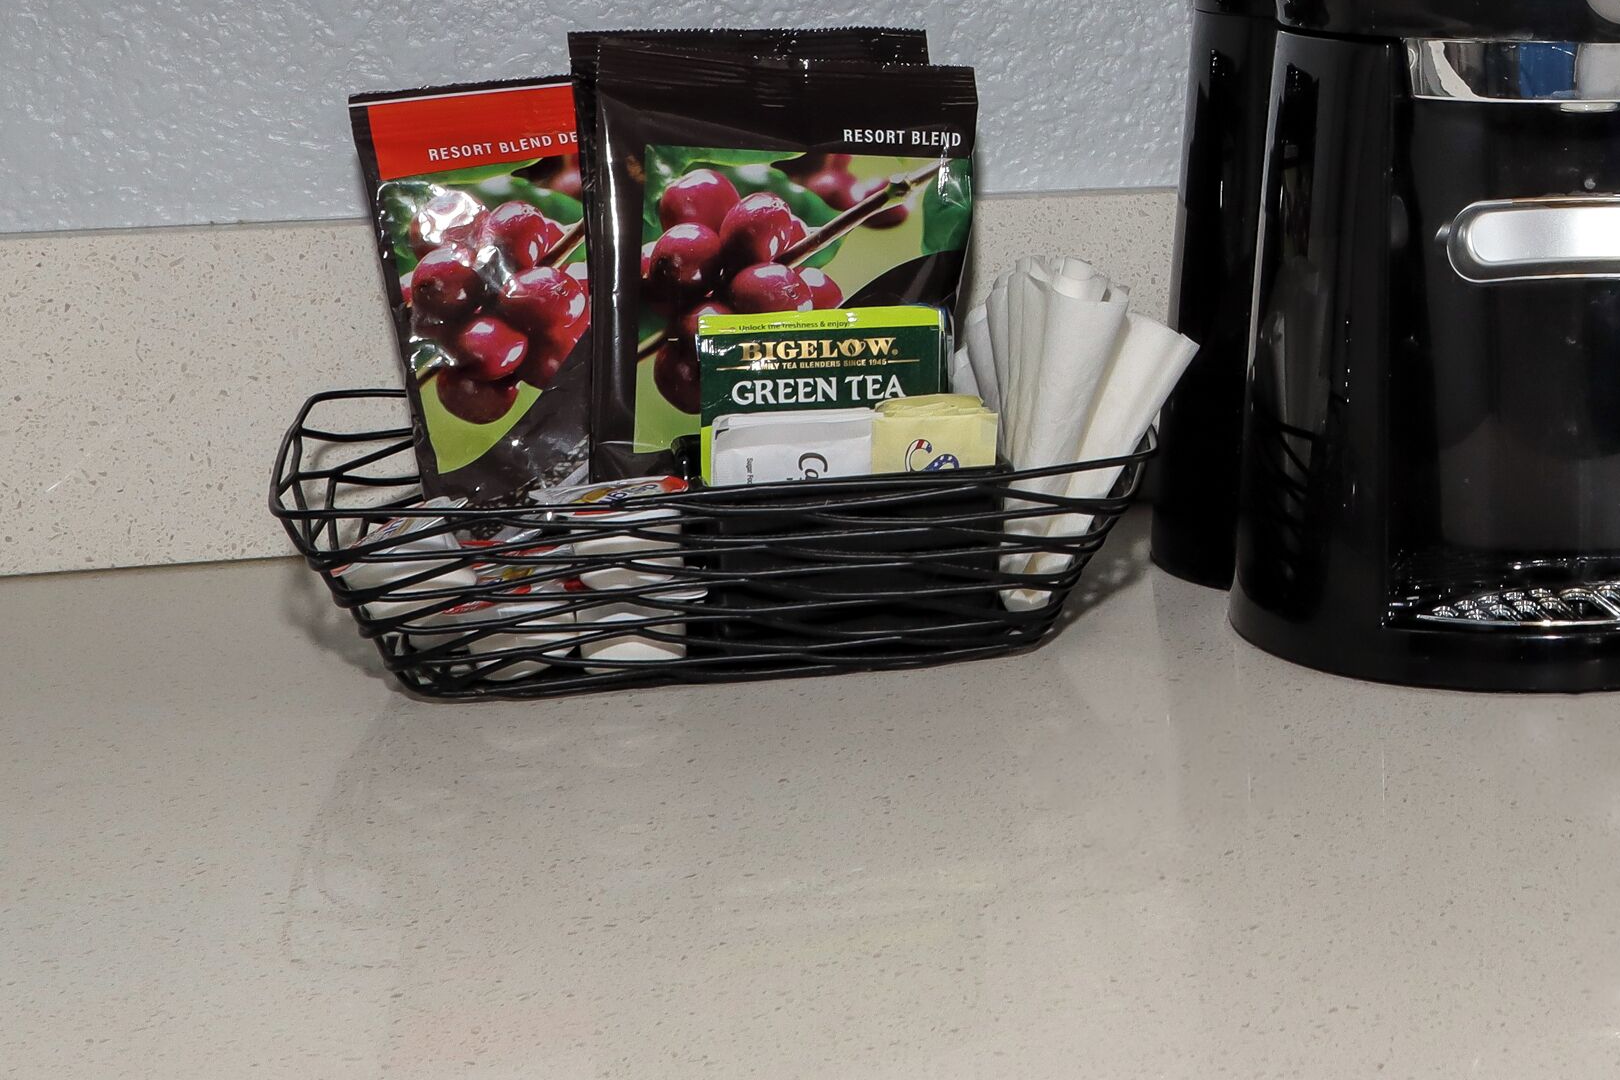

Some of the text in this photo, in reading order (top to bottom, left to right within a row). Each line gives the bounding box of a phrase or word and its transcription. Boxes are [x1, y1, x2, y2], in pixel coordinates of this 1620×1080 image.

[428, 142, 493, 162] RESORT
[499, 135, 552, 154] BLEND
[843, 128, 961, 147] RESORT BLEND
[738, 337, 899, 361] BIGELOW
[782, 361, 798, 369] TEA
[799, 359, 841, 368] BLENDERS
[843, 358, 867, 367] SINCE
[869, 358, 887, 366] 1945
[731, 374, 906, 405] GREEN TEA
